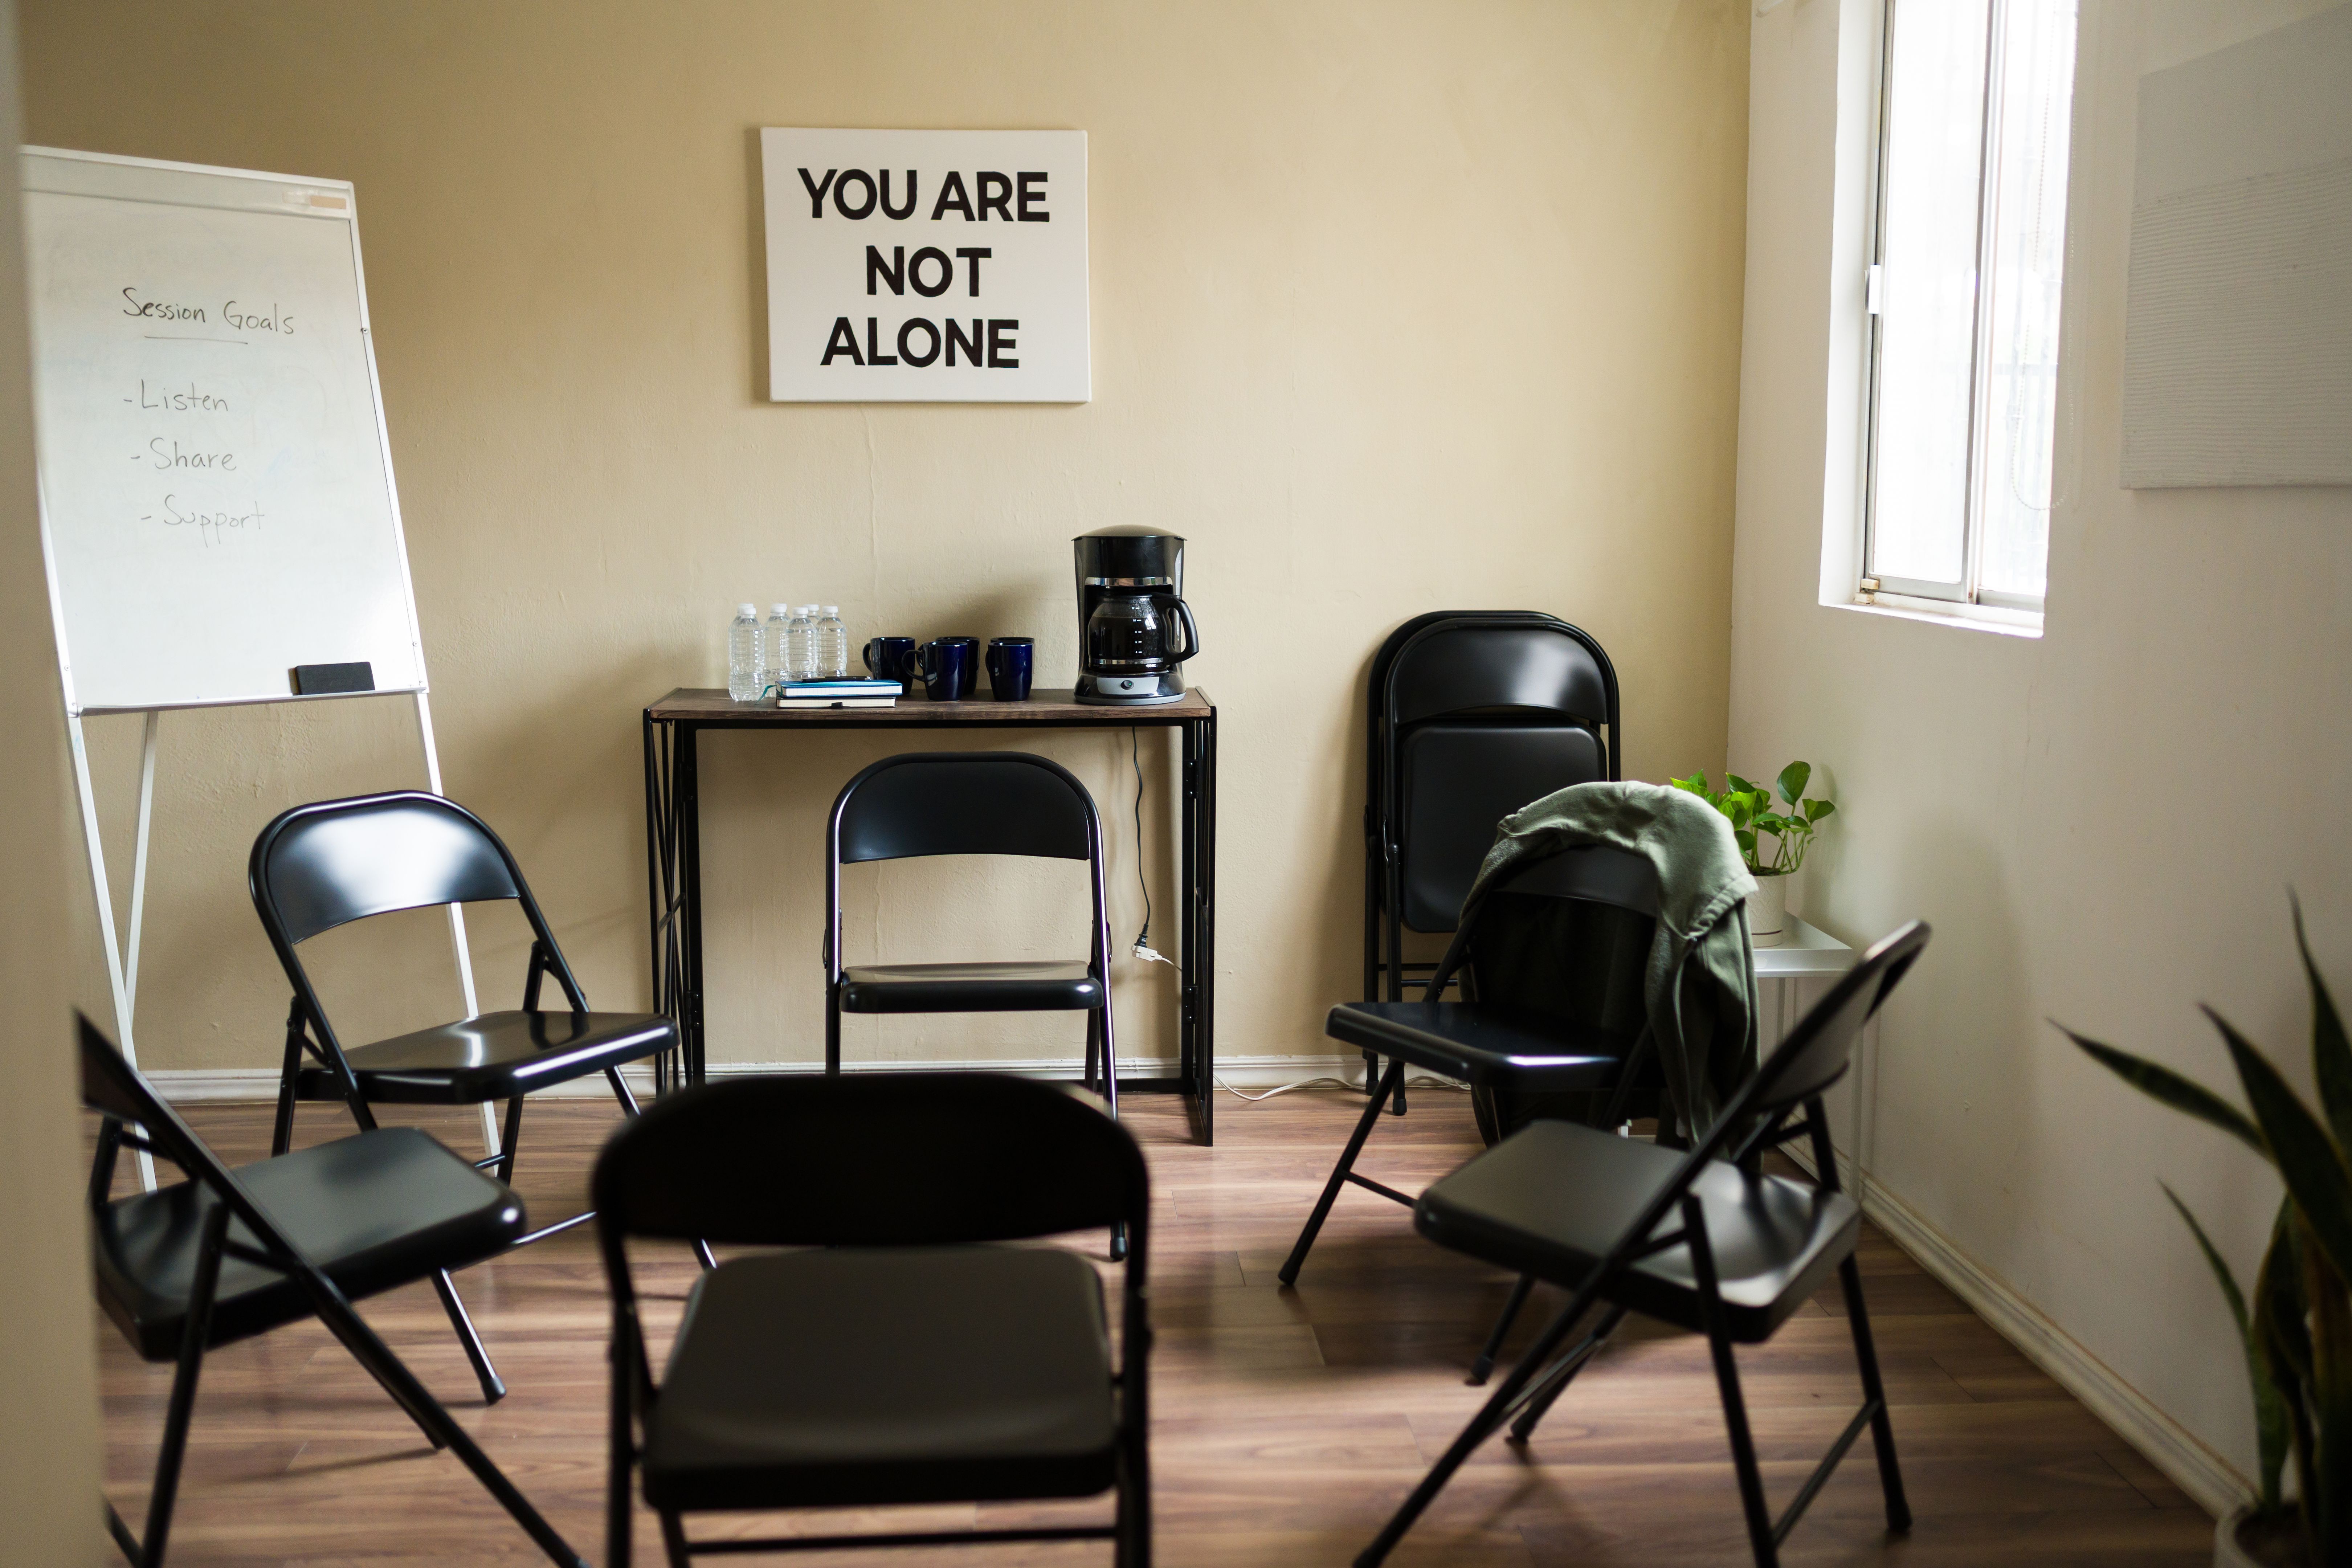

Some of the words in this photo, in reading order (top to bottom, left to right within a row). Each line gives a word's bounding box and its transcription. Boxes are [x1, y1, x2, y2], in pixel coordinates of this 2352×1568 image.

[797, 168, 917, 220] YOU
[931, 171, 1050, 222] ARE
[866, 245, 992, 297] NOT
[122, 287, 206, 323] Session
[223, 300, 294, 334] Goals
[820, 317, 1019, 368] ALONE
